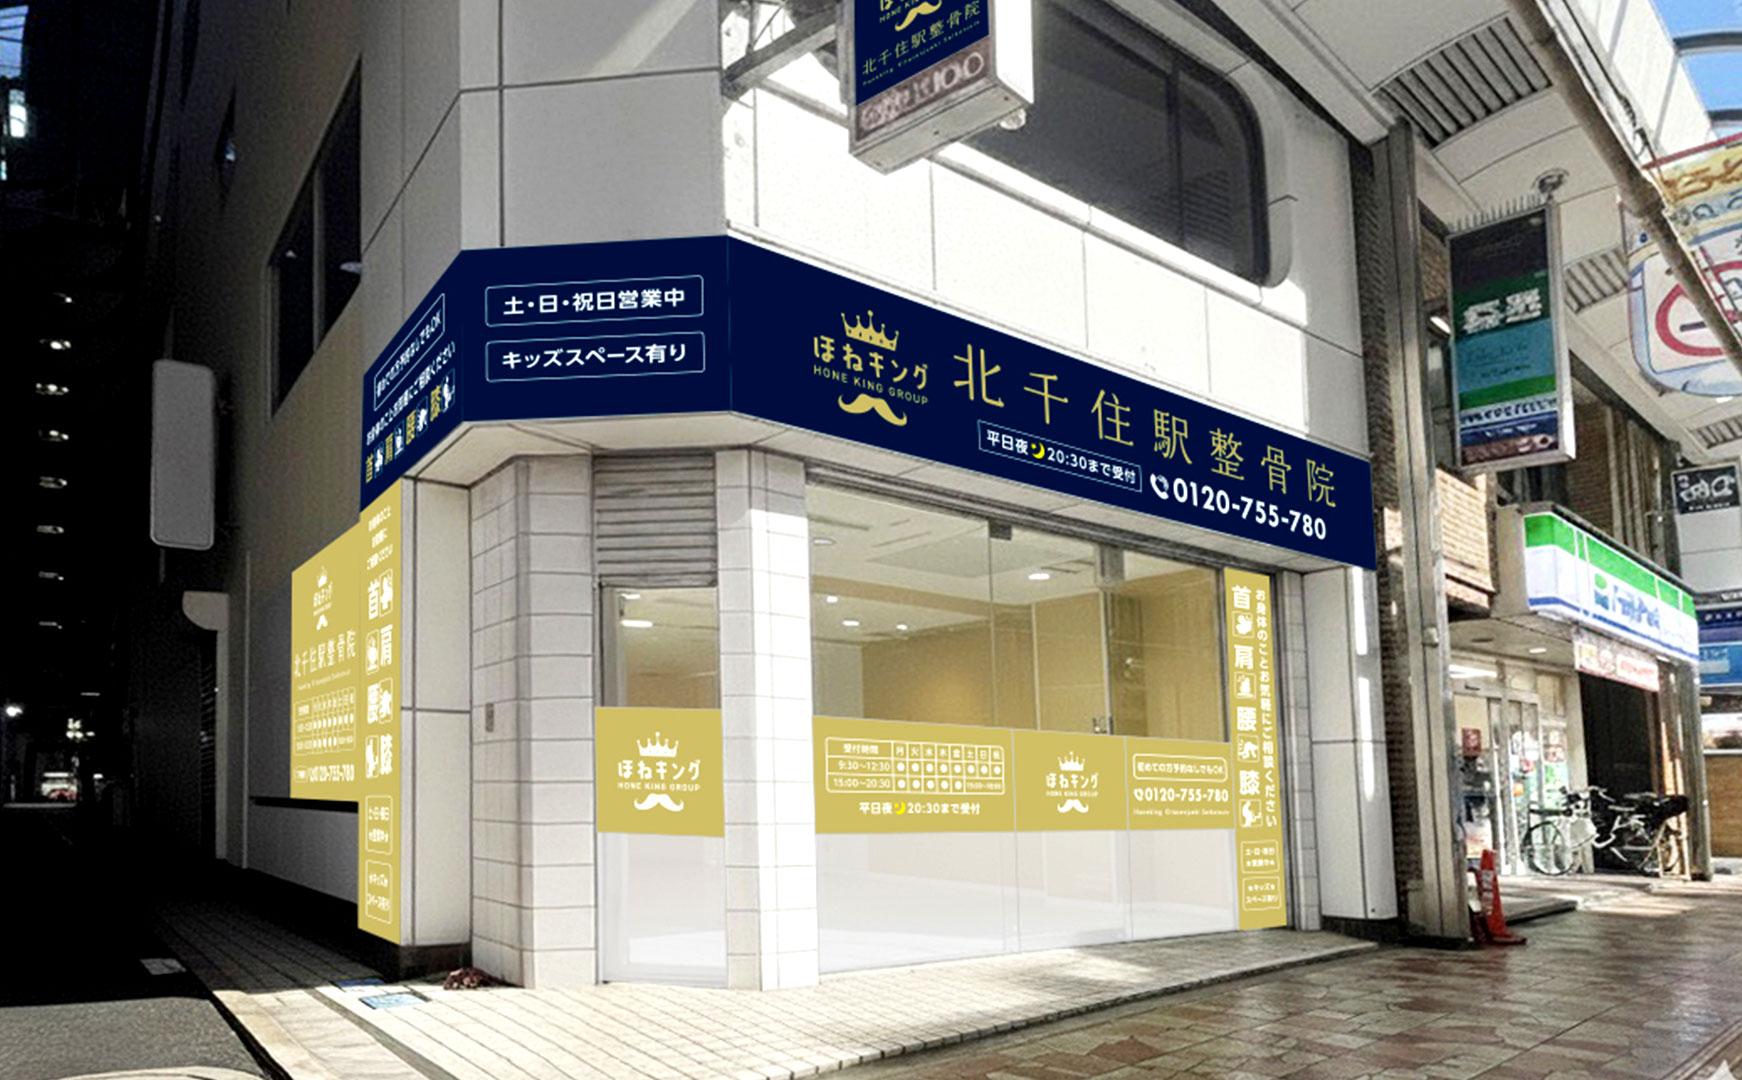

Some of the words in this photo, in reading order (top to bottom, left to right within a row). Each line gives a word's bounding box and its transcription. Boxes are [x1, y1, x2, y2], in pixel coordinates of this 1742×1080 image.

[862, 0, 981, 76] 北千住駅整骨院
[503, 287, 686, 316] 土・日・祝日営業中
[501, 342, 687, 370] キッズスペース有り
[813, 335, 928, 390] ほねキング
[813, 364, 849, 384] HONE
[853, 375, 884, 394] KING
[888, 386, 929, 405] GROUP
[953, 343, 1337, 509] 北千住駅整骨院
[1173, 477, 1327, 541] 0120-755-780
[1231, 584, 1252, 610] 首
[1233, 644, 1254, 671] 肩
[617, 759, 702, 781] ほねキング
[1046, 772, 1099, 789] ほねキング
[1144, 787, 1229, 803] 0120-755-780
